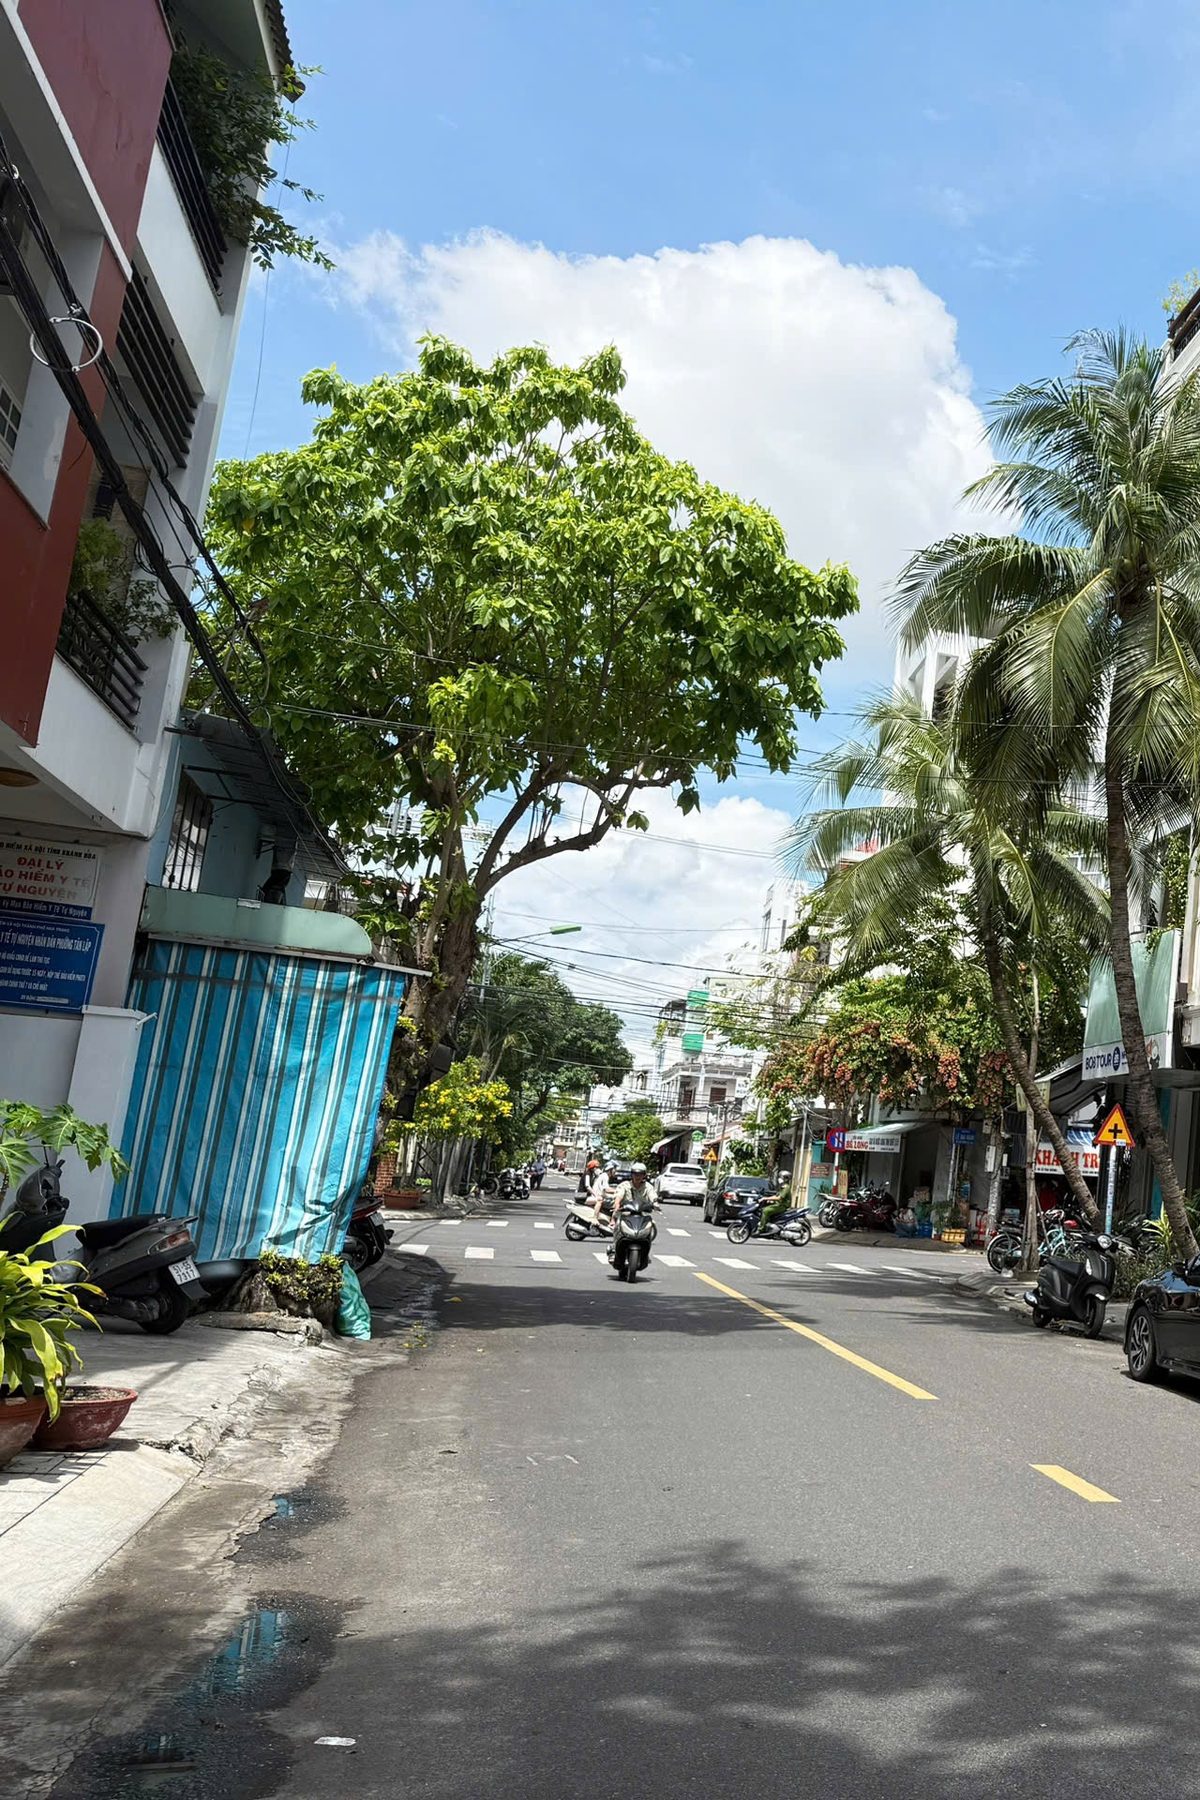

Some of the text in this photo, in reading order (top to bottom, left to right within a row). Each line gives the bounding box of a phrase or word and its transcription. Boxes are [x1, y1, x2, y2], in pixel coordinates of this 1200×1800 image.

[17, 857, 43, 869] ĐẠI
[18, 868, 55, 883] HIỂM
[60, 876, 68, 885] Y
[177, 1269, 195, 1282] 7317
